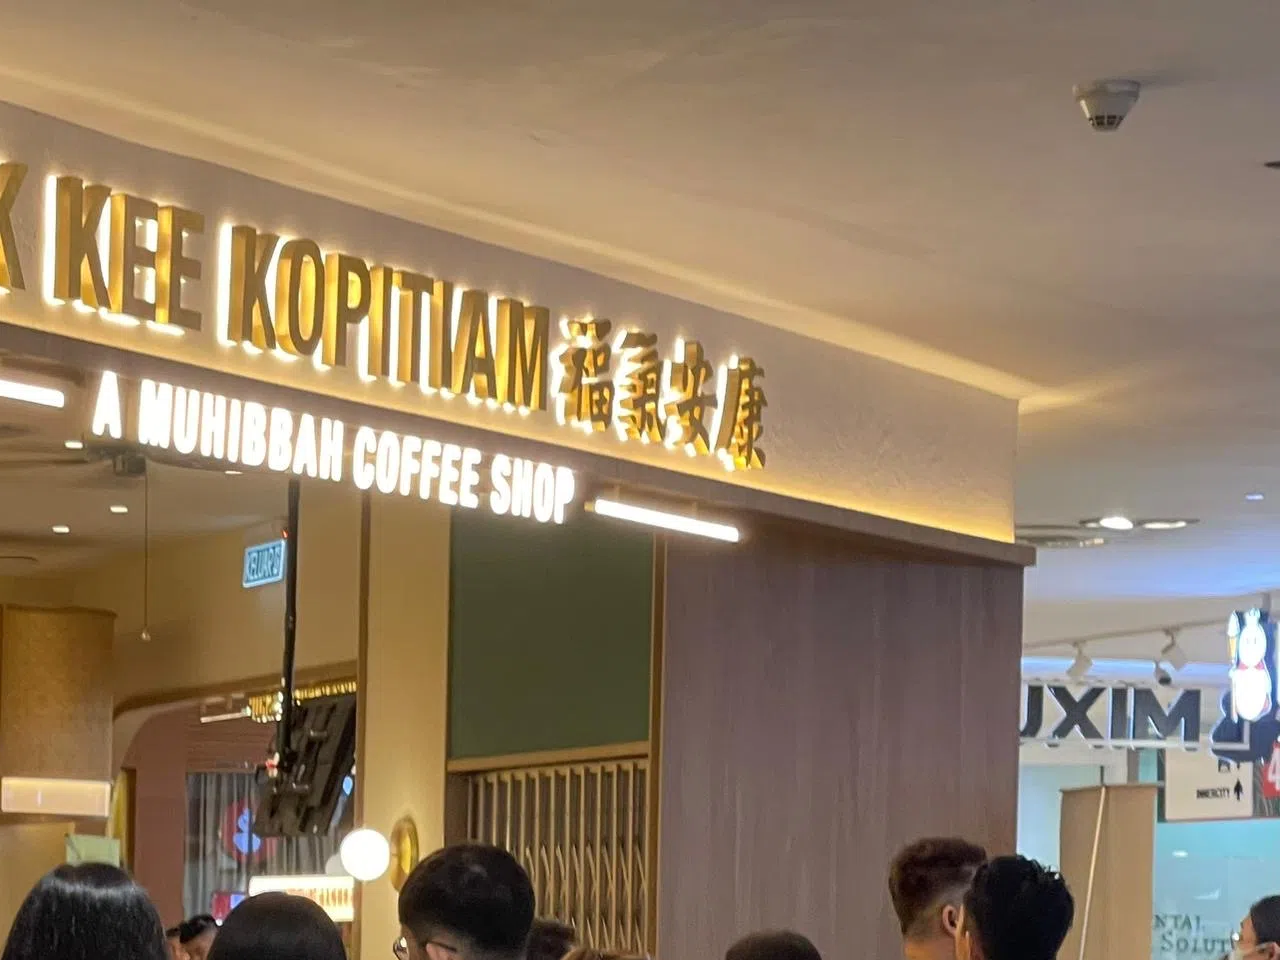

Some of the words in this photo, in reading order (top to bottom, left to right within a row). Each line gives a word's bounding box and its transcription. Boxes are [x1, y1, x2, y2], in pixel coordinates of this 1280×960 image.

[48, 176, 204, 331] KEE
[223, 224, 550, 413] KOPITIAM
[92, 370, 122, 439] A
[138, 378, 344, 482] MUHIBBAH
[353, 426, 481, 509] COFFEE
[489, 454, 575, 524] SHOP
